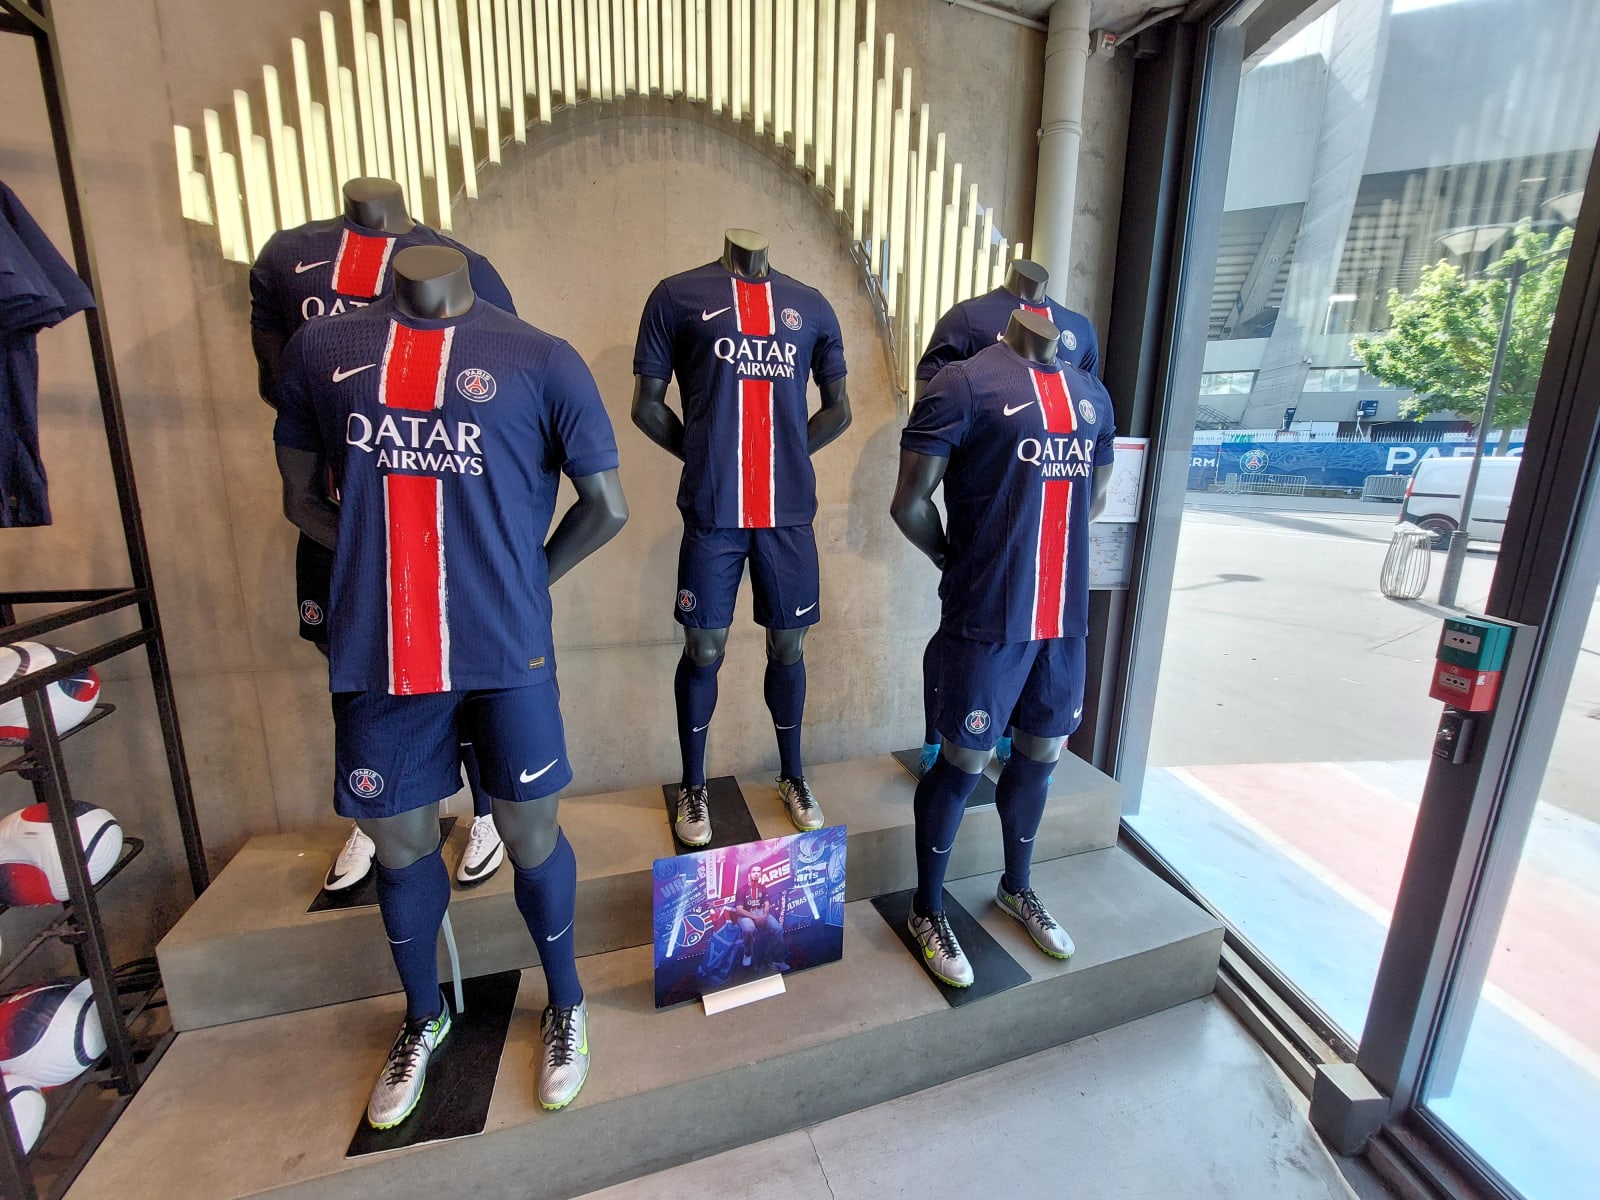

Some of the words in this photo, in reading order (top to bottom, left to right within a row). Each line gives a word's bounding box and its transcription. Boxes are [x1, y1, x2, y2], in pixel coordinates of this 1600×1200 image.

[713, 337, 796, 366] QATAR
[346, 412, 483, 454] QATAR
[376, 448, 484, 477] AIRWAYS
[1016, 437, 1094, 467] QATAR
